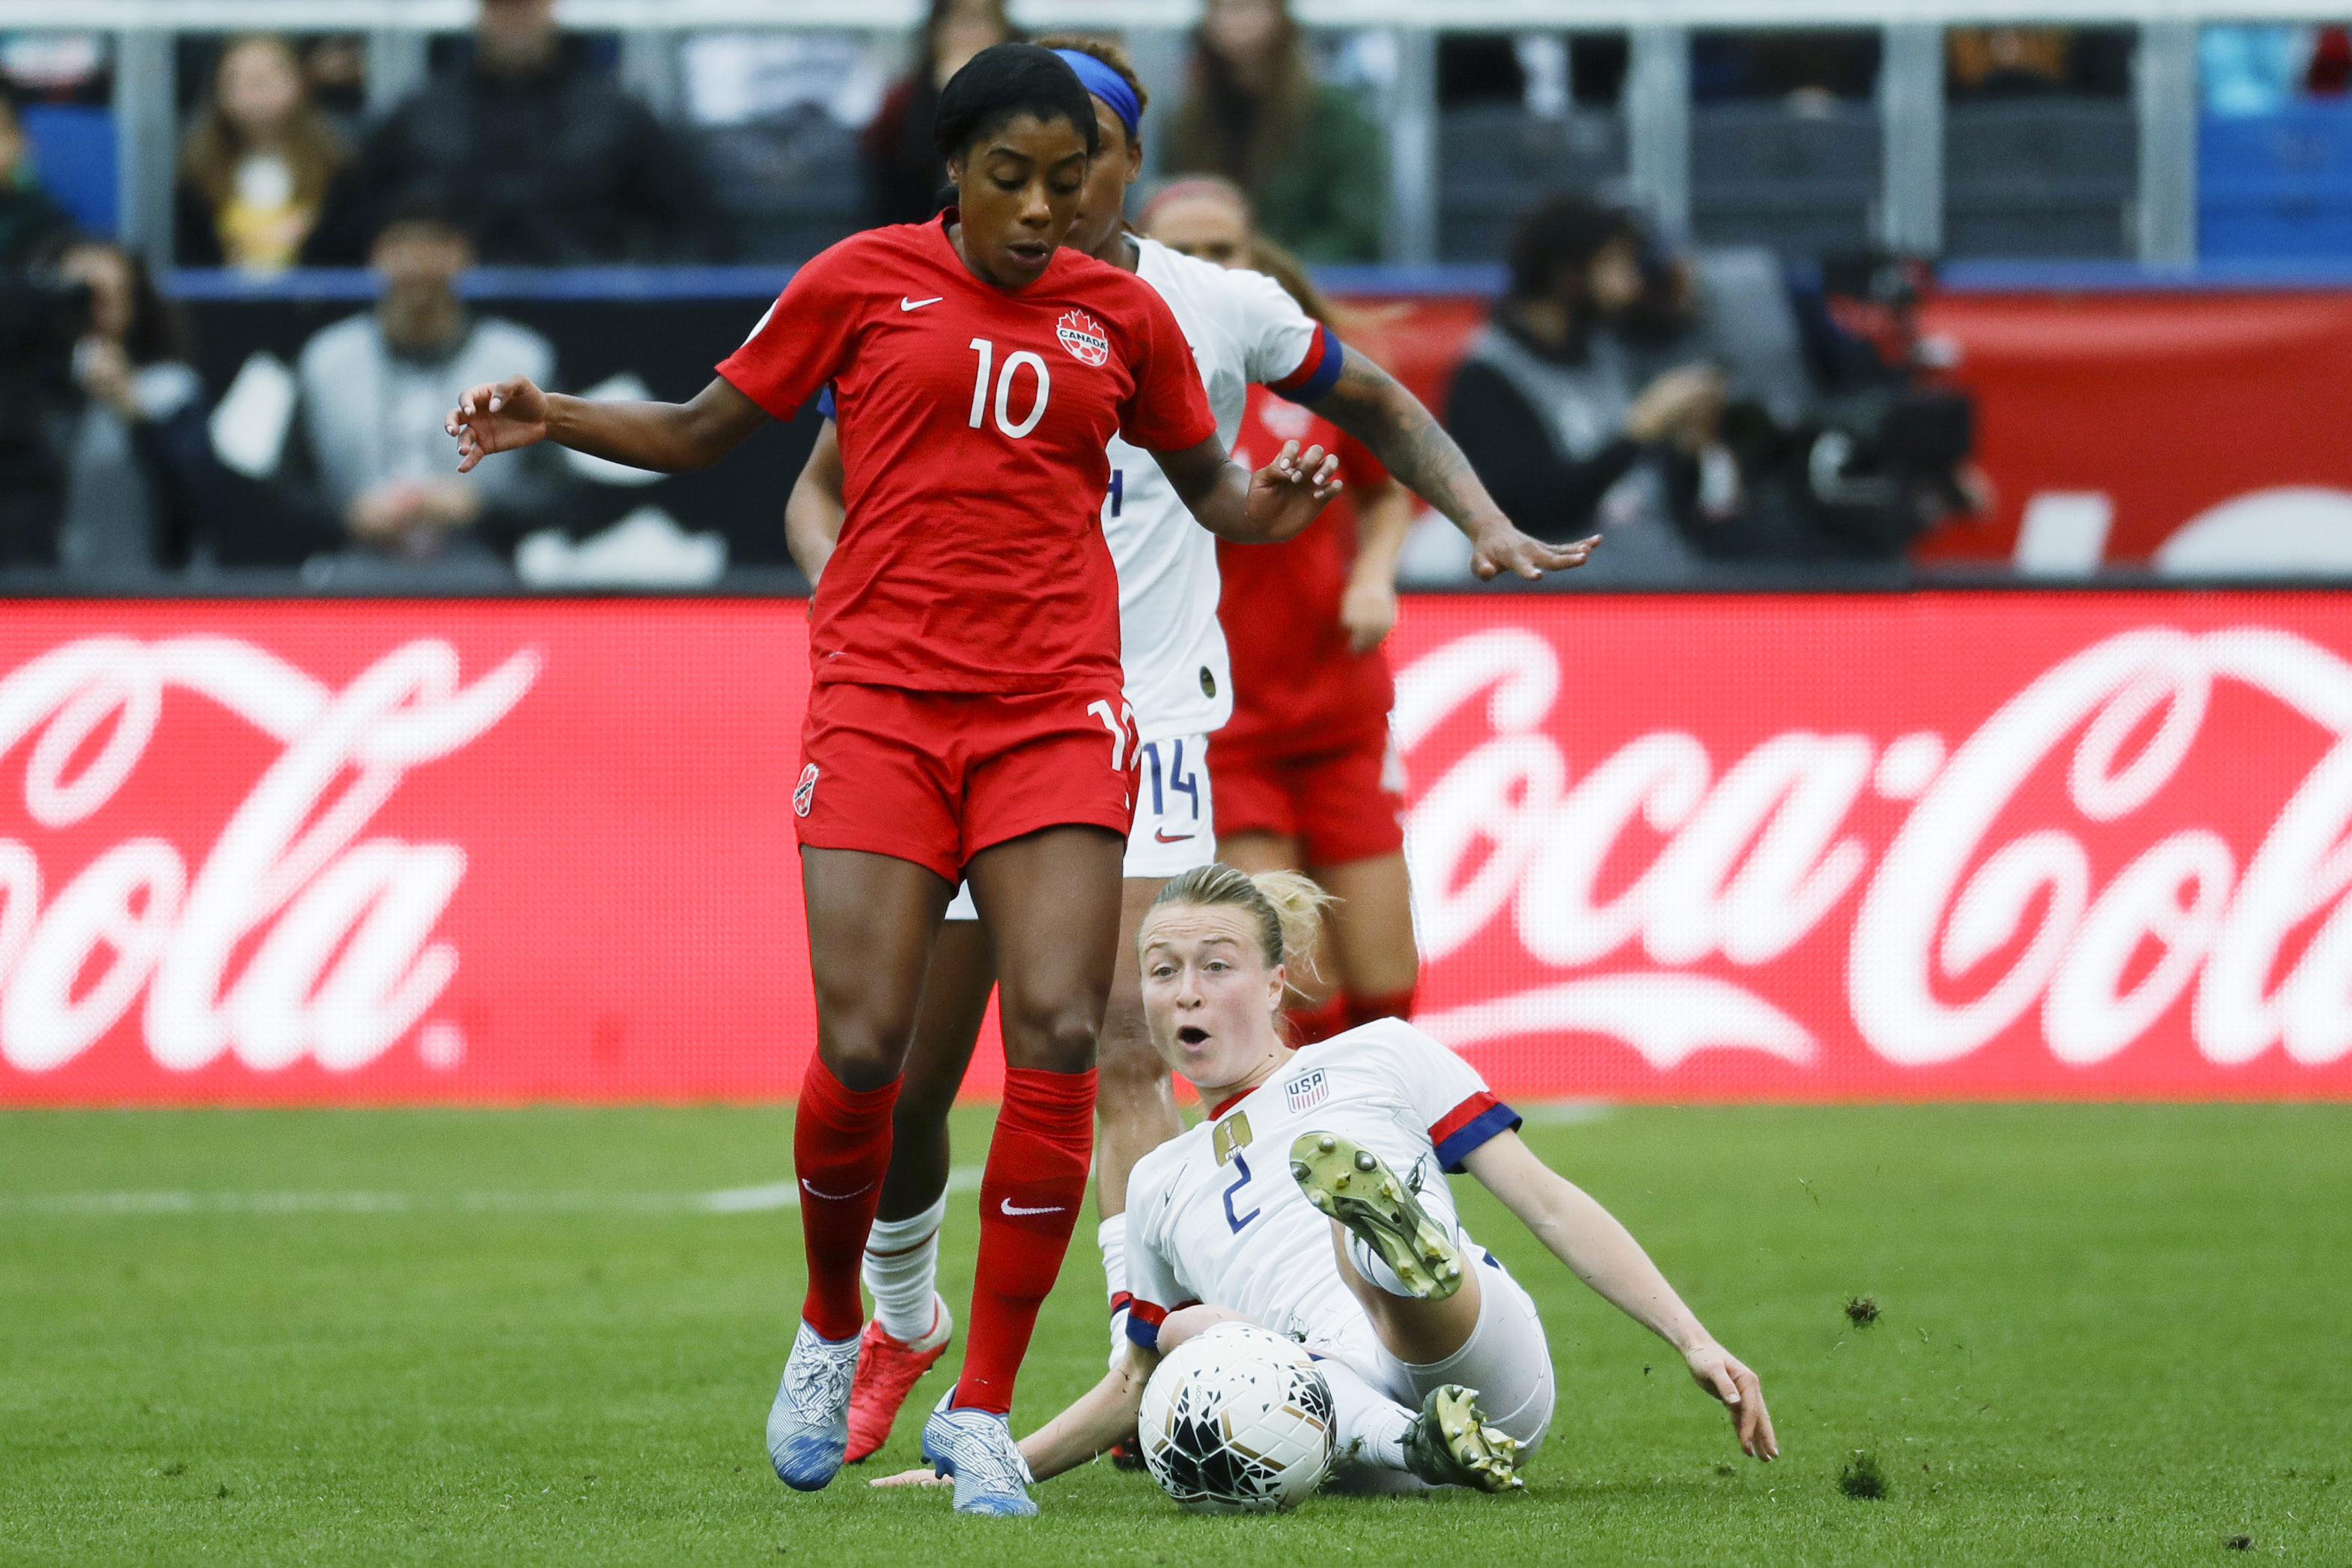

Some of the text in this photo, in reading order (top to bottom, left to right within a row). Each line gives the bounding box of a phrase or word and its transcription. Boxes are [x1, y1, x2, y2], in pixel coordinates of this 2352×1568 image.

[1059, 329, 1107, 351] CANADA
[969, 338, 1050, 439] 10
[1142, 739, 1198, 820] 14
[1289, 1073, 1322, 1095] USA
[1222, 1152, 1261, 1235] 2
